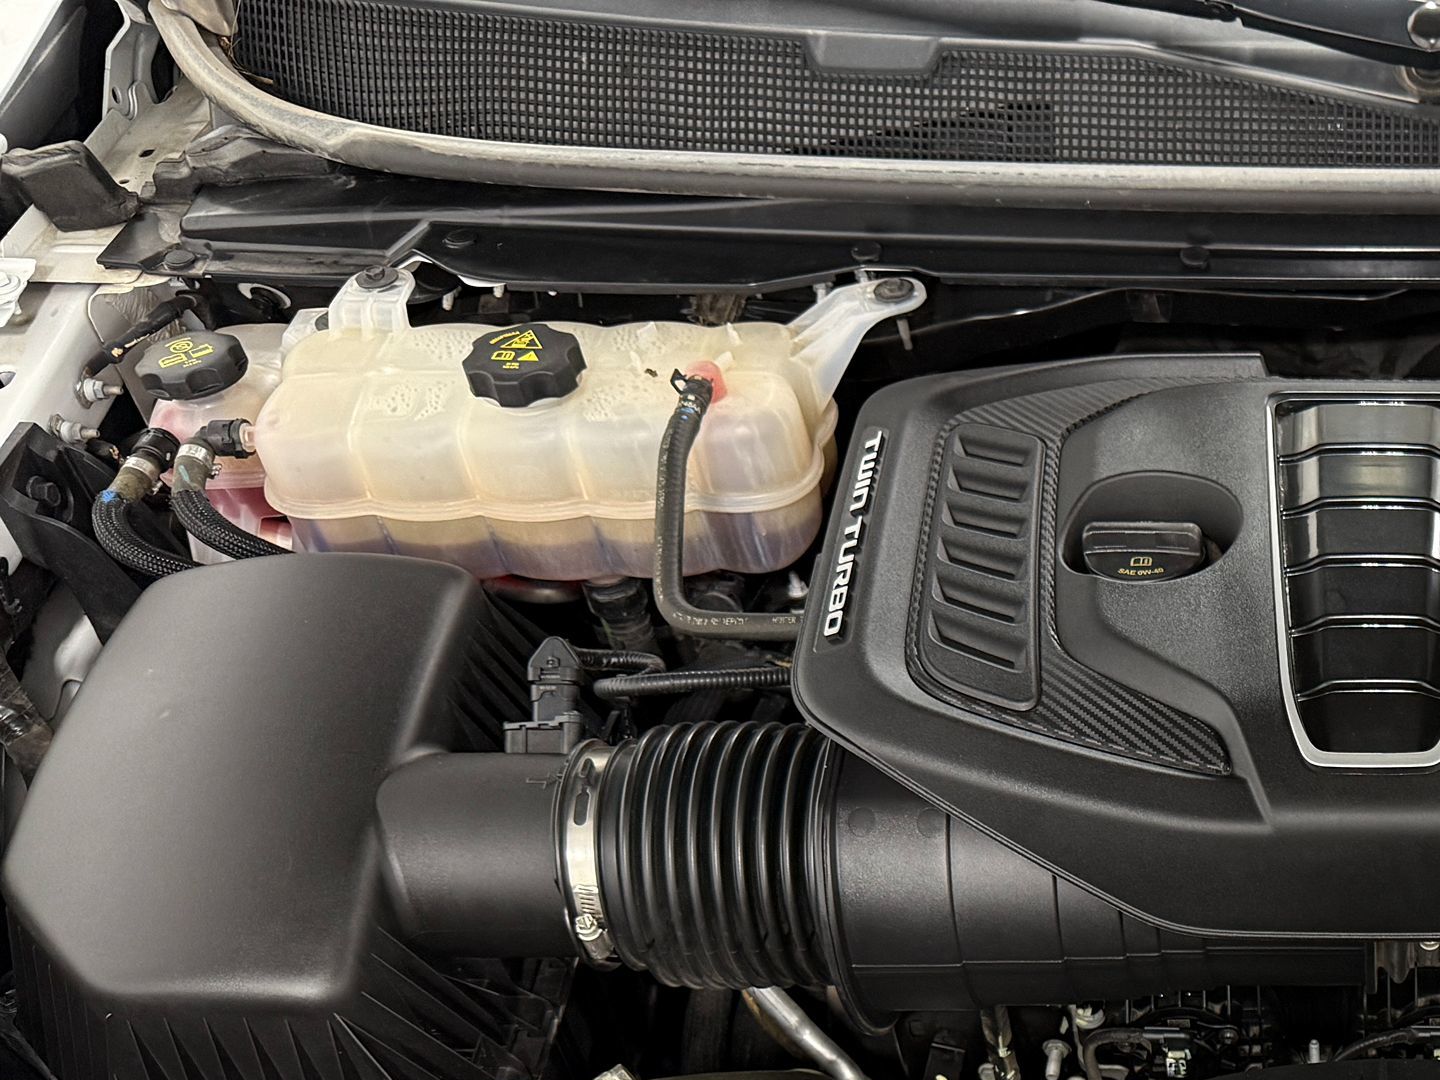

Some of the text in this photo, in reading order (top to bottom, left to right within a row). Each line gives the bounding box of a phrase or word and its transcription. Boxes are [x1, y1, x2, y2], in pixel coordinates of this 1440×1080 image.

[824, 430, 882, 636] TWIN TURBO
[1118, 568, 1136, 576] SAE
